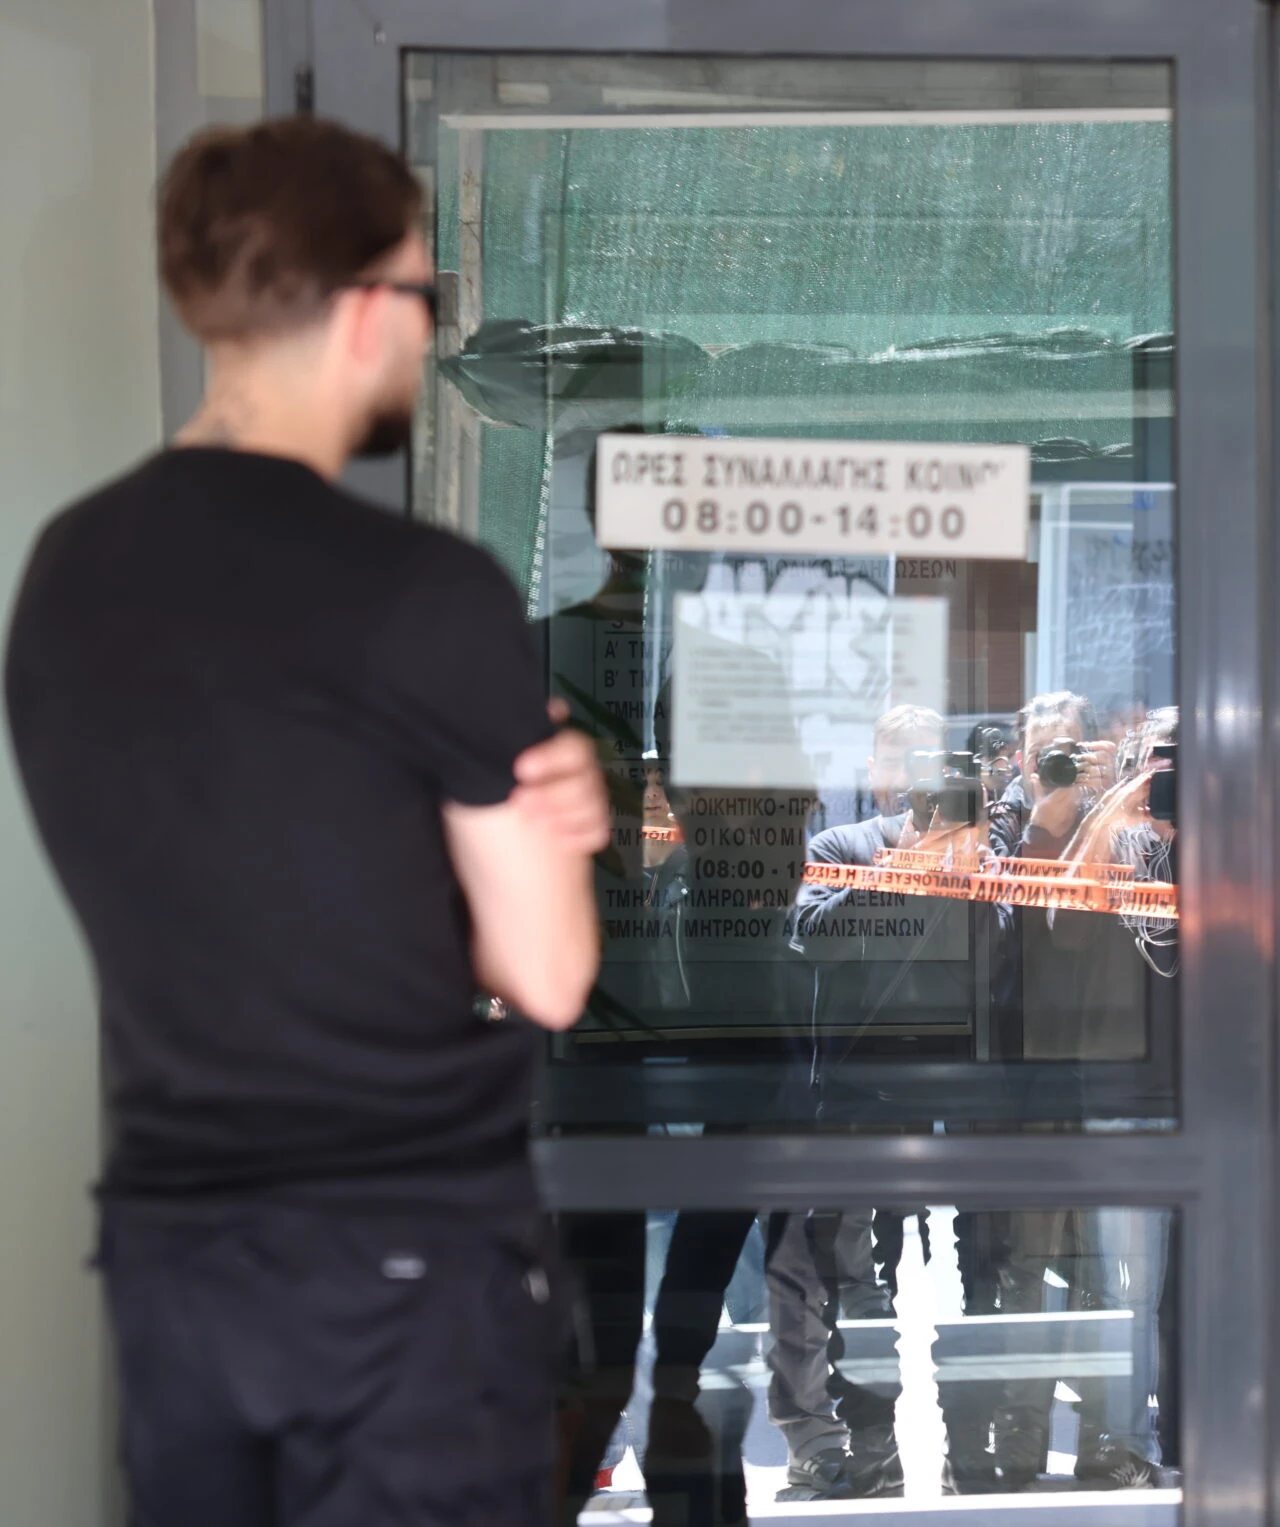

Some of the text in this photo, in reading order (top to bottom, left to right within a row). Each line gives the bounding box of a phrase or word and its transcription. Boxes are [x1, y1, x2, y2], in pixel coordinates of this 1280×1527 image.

[611, 452, 687, 486] ΩΡΕΣ
[702, 454, 888, 491] ΣΥΝΑΛΛΑΓΗΣ
[695, 827, 803, 847] ΟΙΚΟΝΟΜΙ
[685, 918, 772, 938] ΜΗΤΡΩΟΥ
